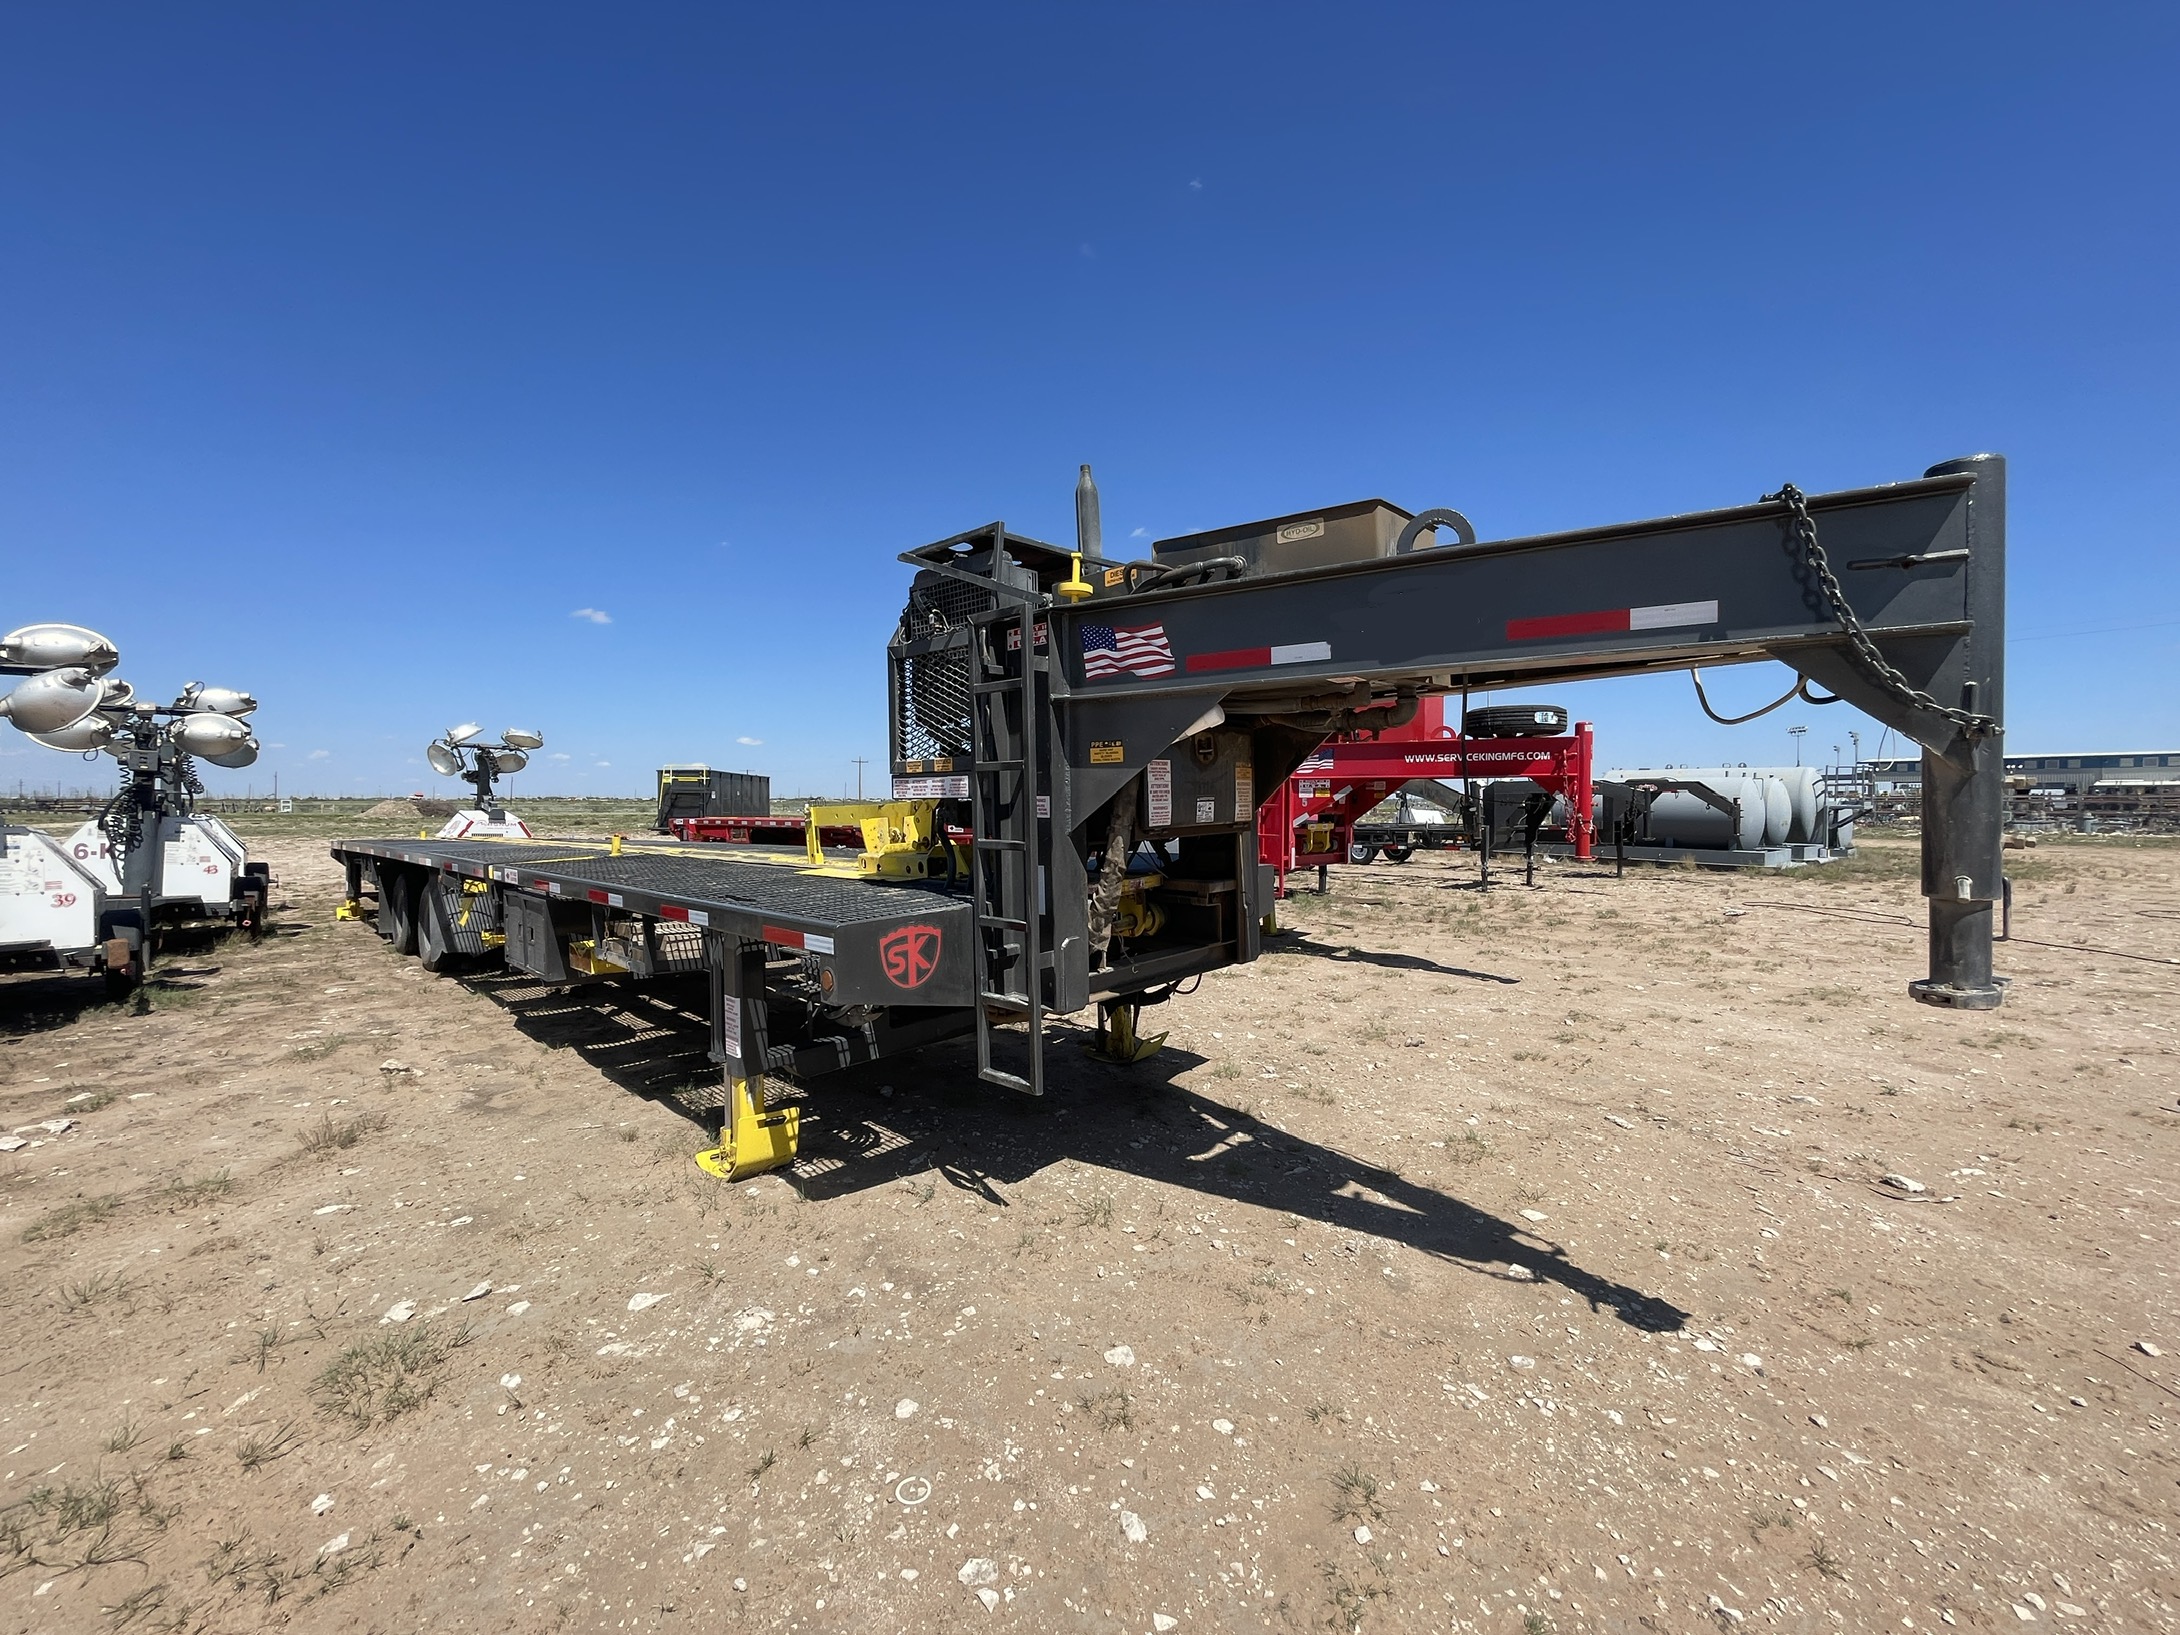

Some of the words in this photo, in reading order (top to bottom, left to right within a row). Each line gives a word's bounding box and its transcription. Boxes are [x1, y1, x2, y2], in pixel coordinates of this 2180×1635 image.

[1285, 525, 1315, 537] HYD-OIL
[1404, 751, 1551, 763] WWW.SERVCEKINGMFG.COM
[50, 893, 77, 908] 39
